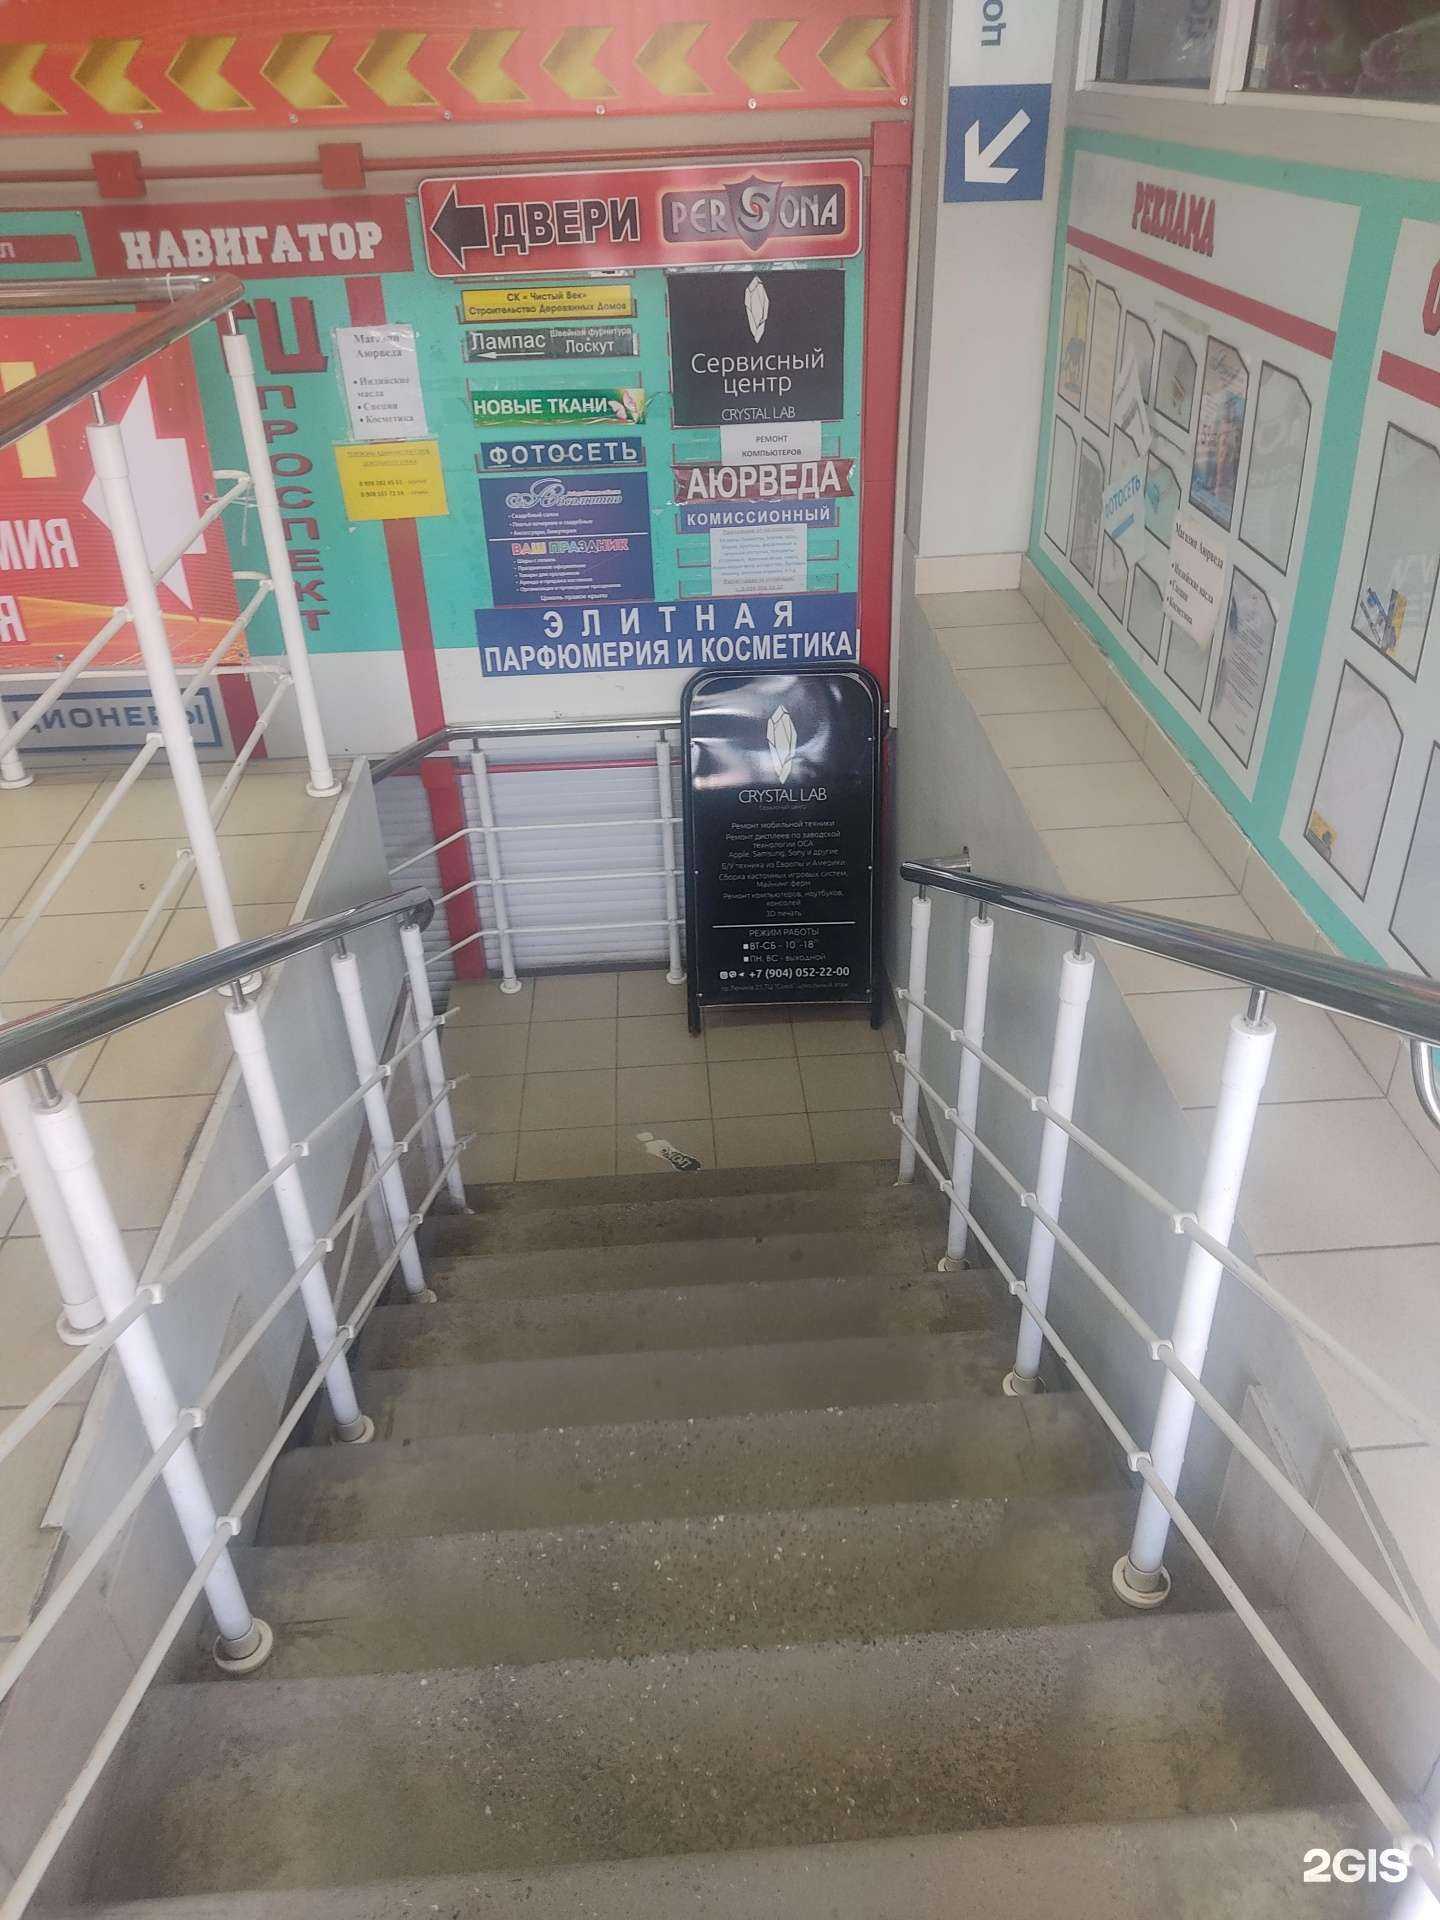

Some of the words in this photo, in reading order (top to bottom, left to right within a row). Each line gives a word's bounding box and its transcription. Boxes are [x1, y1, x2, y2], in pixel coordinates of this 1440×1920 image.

[670, 185, 838, 233] PERSONA
[493, 197, 639, 255] ДВЕРИ
[1131, 181, 1217, 258] РЕКЛАМА
[120, 222, 383, 269] НАВИГАТОР
[506, 294, 520, 302] СК
[530, 292, 562, 301] Чистый
[468, 307, 537, 316] Строительство
[539, 304, 594, 314] Деревянных
[597, 302, 628, 311] Домов
[470, 331, 546, 351] Лампас
[550, 328, 586, 338] Швейная
[588, 326, 632, 337] фурнитура
[565, 340, 616, 355] Лоскут
[691, 345, 825, 376] Сервисный
[724, 375, 793, 397] центр
[474, 400, 544, 416] НОВЫЕ
[547, 397, 608, 413] ТКАНИ
[721, 406, 771, 421] CRYSTAL
[773, 405, 797, 419] LAB
[755, 435, 789, 444] РЕМОНТ
[741, 448, 802, 458] КОМПЬЮТЕРОВ
[687, 460, 842, 500] АЮРВЕДА
[256, 385, 330, 632] ПРОСПЕКТ
[687, 505, 831, 527] КОМИССИОННЫЙ
[511, 541, 548, 556] ВАШ
[549, 538, 630, 554] ПРАЗДНИК
[543, 601, 793, 639] ЭЛИТНАЯ
[484, 639, 670, 673] ПАРФЮМЕРИЯ
[677, 638, 694, 664] И
[701, 631, 853, 663] КОСМЕТИКА
[738, 789, 798, 803] CRYSTAL
[800, 787, 828, 801] LAB
[749, 929, 783, 938] РЕЖИМ
[784, 928, 820, 937] РАБОТЫ
[749, 969, 762, 979] +7
[765, 967, 793, 980] (904)
[795, 966, 850, 977] 052-22-00
